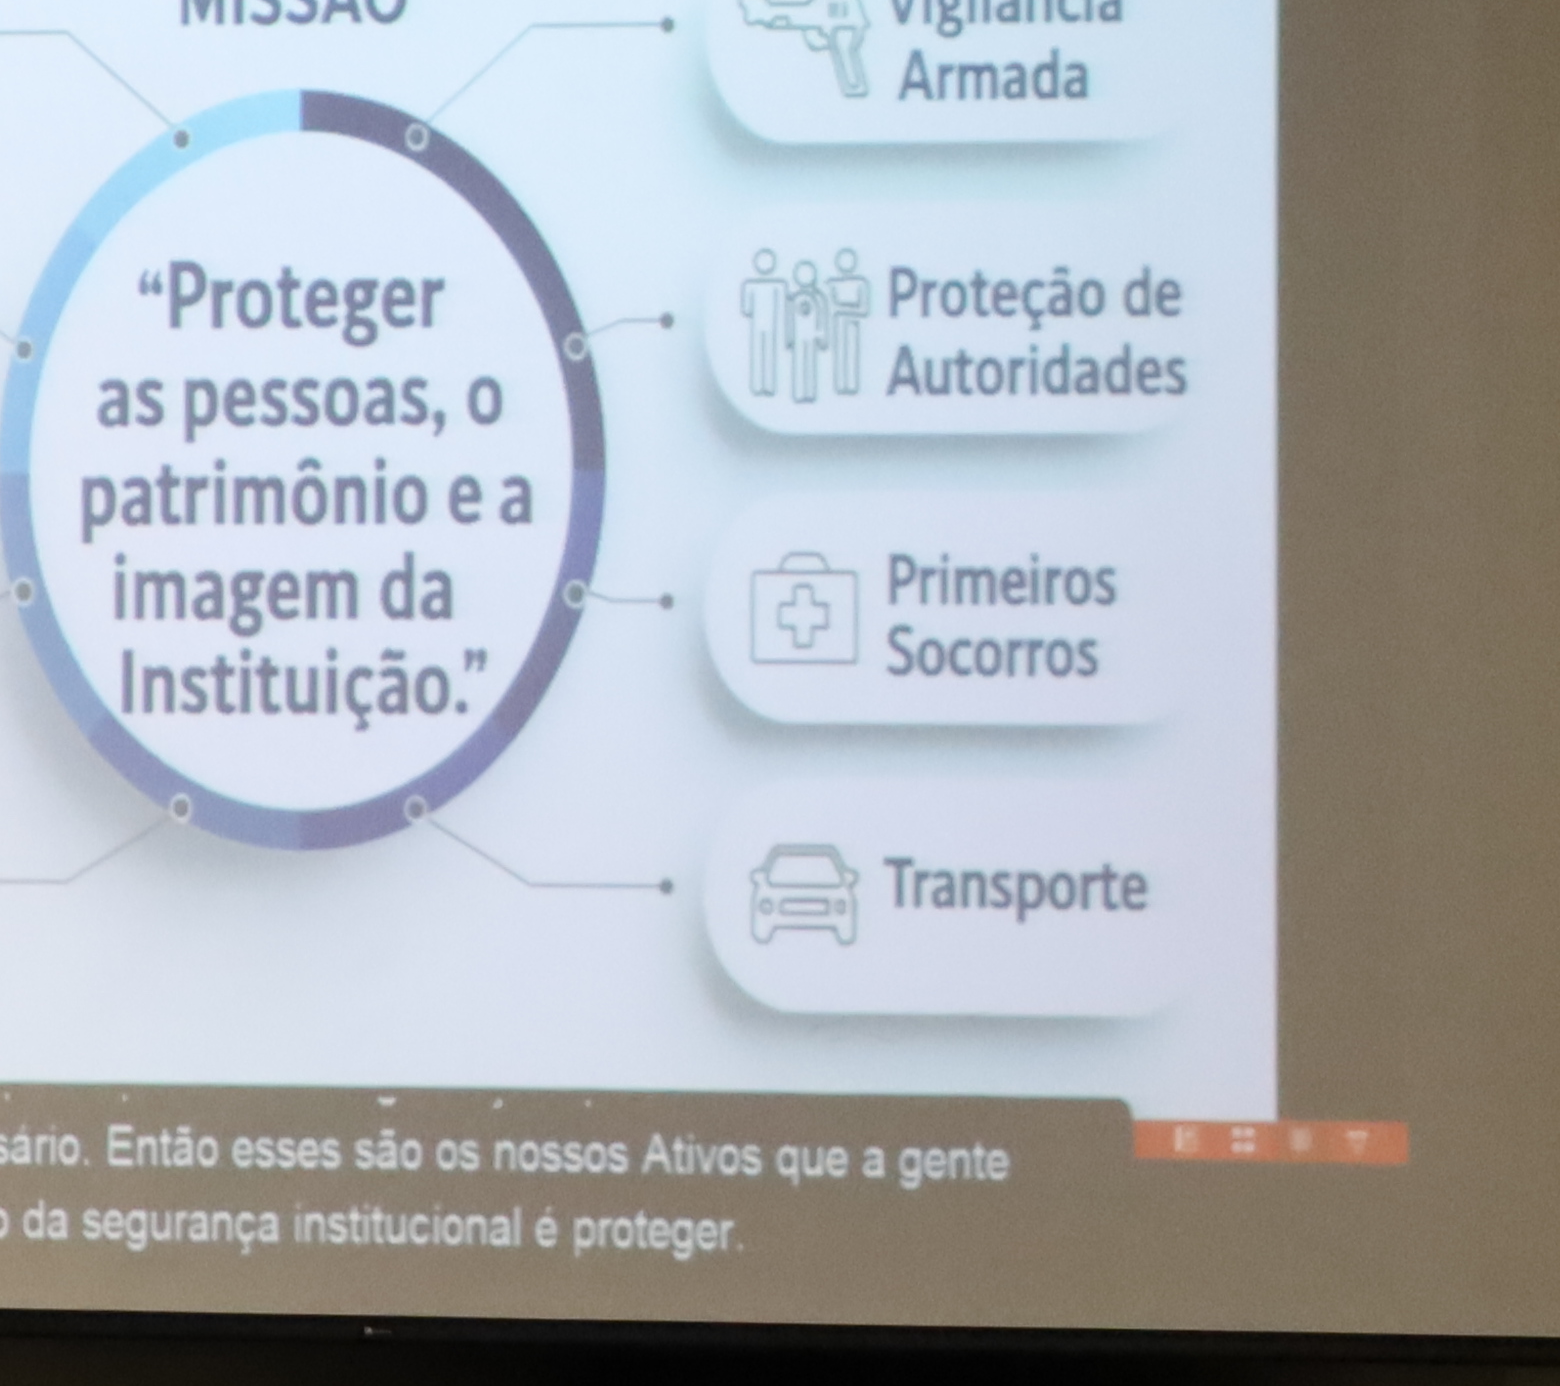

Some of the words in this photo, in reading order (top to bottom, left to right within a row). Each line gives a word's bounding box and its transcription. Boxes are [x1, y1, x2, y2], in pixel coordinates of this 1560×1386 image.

[898, 47, 1091, 101] Armada
[890, 264, 1107, 330] Proteção
[1123, 264, 1183, 318] de
[887, 344, 1190, 396] Autoridades
[97, 378, 165, 428] as
[184, 376, 447, 444] pessoas,
[467, 375, 504, 426] o
[81, 456, 430, 544] patrimônio
[448, 474, 484, 525] e
[499, 475, 533, 525] a
[114, 552, 359, 638] imagem
[380, 550, 454, 621] da
[889, 553, 1118, 607] Primeiros
[887, 623, 1100, 678] Socorros
[884, 855, 1150, 924] Transporte
[107, 1124, 219, 1168] Então
[232, 1140, 342, 1169] esses
[355, 1128, 421, 1170] são
[436, 1139, 480, 1172] os
[494, 1140, 629, 1175] nossos
[641, 1133, 764, 1178] Ativos
[774, 1144, 850, 1185] que
[862, 1146, 886, 1178] a
[897, 1143, 1012, 1191] gente
[22, 1200, 69, 1240] da
[82, 1208, 281, 1256] segurança
[294, 1205, 522, 1247] institucional
[533, 1206, 559, 1248] é
[573, 1210, 744, 1261] proteger.
